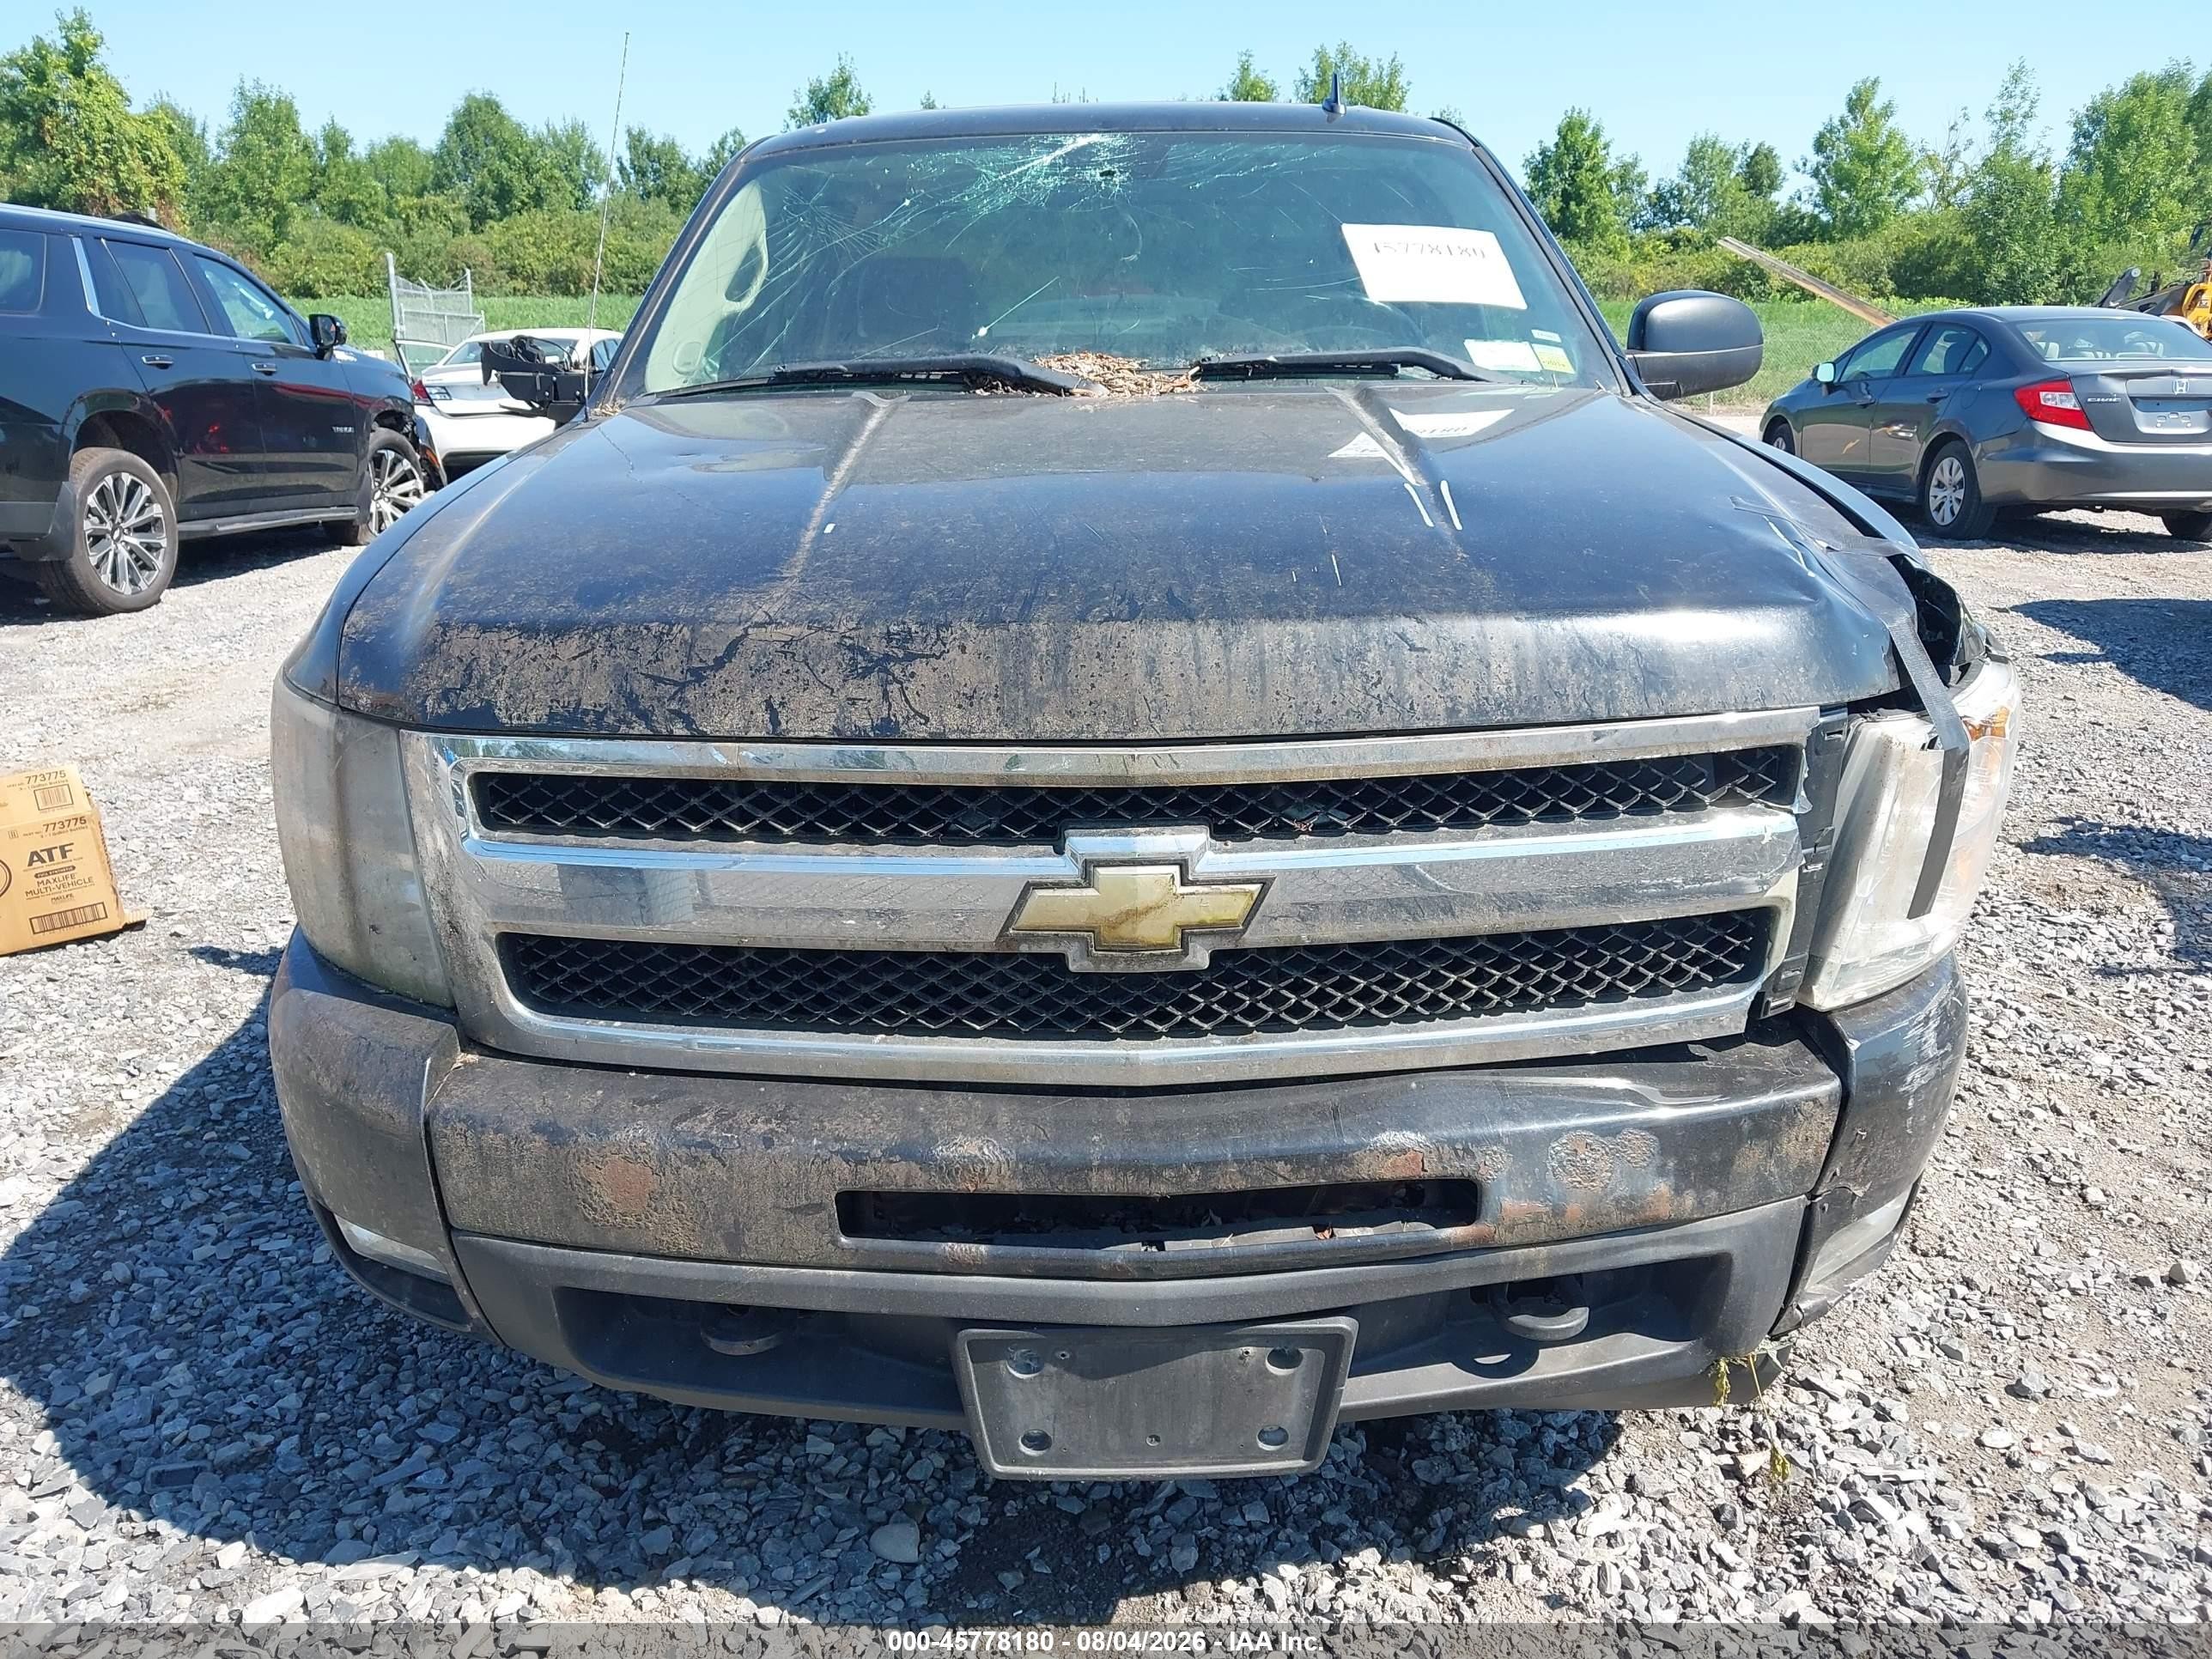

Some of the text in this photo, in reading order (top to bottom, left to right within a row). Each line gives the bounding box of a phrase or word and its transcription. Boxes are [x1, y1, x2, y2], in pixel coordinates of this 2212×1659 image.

[25, 769, 66, 785] 773775
[43, 816, 87, 833] 773775
[27, 842, 75, 867] ATF
[25, 876, 94, 897] MULTI-VEHICLE
[37, 873, 76, 887] MAXLIFE
